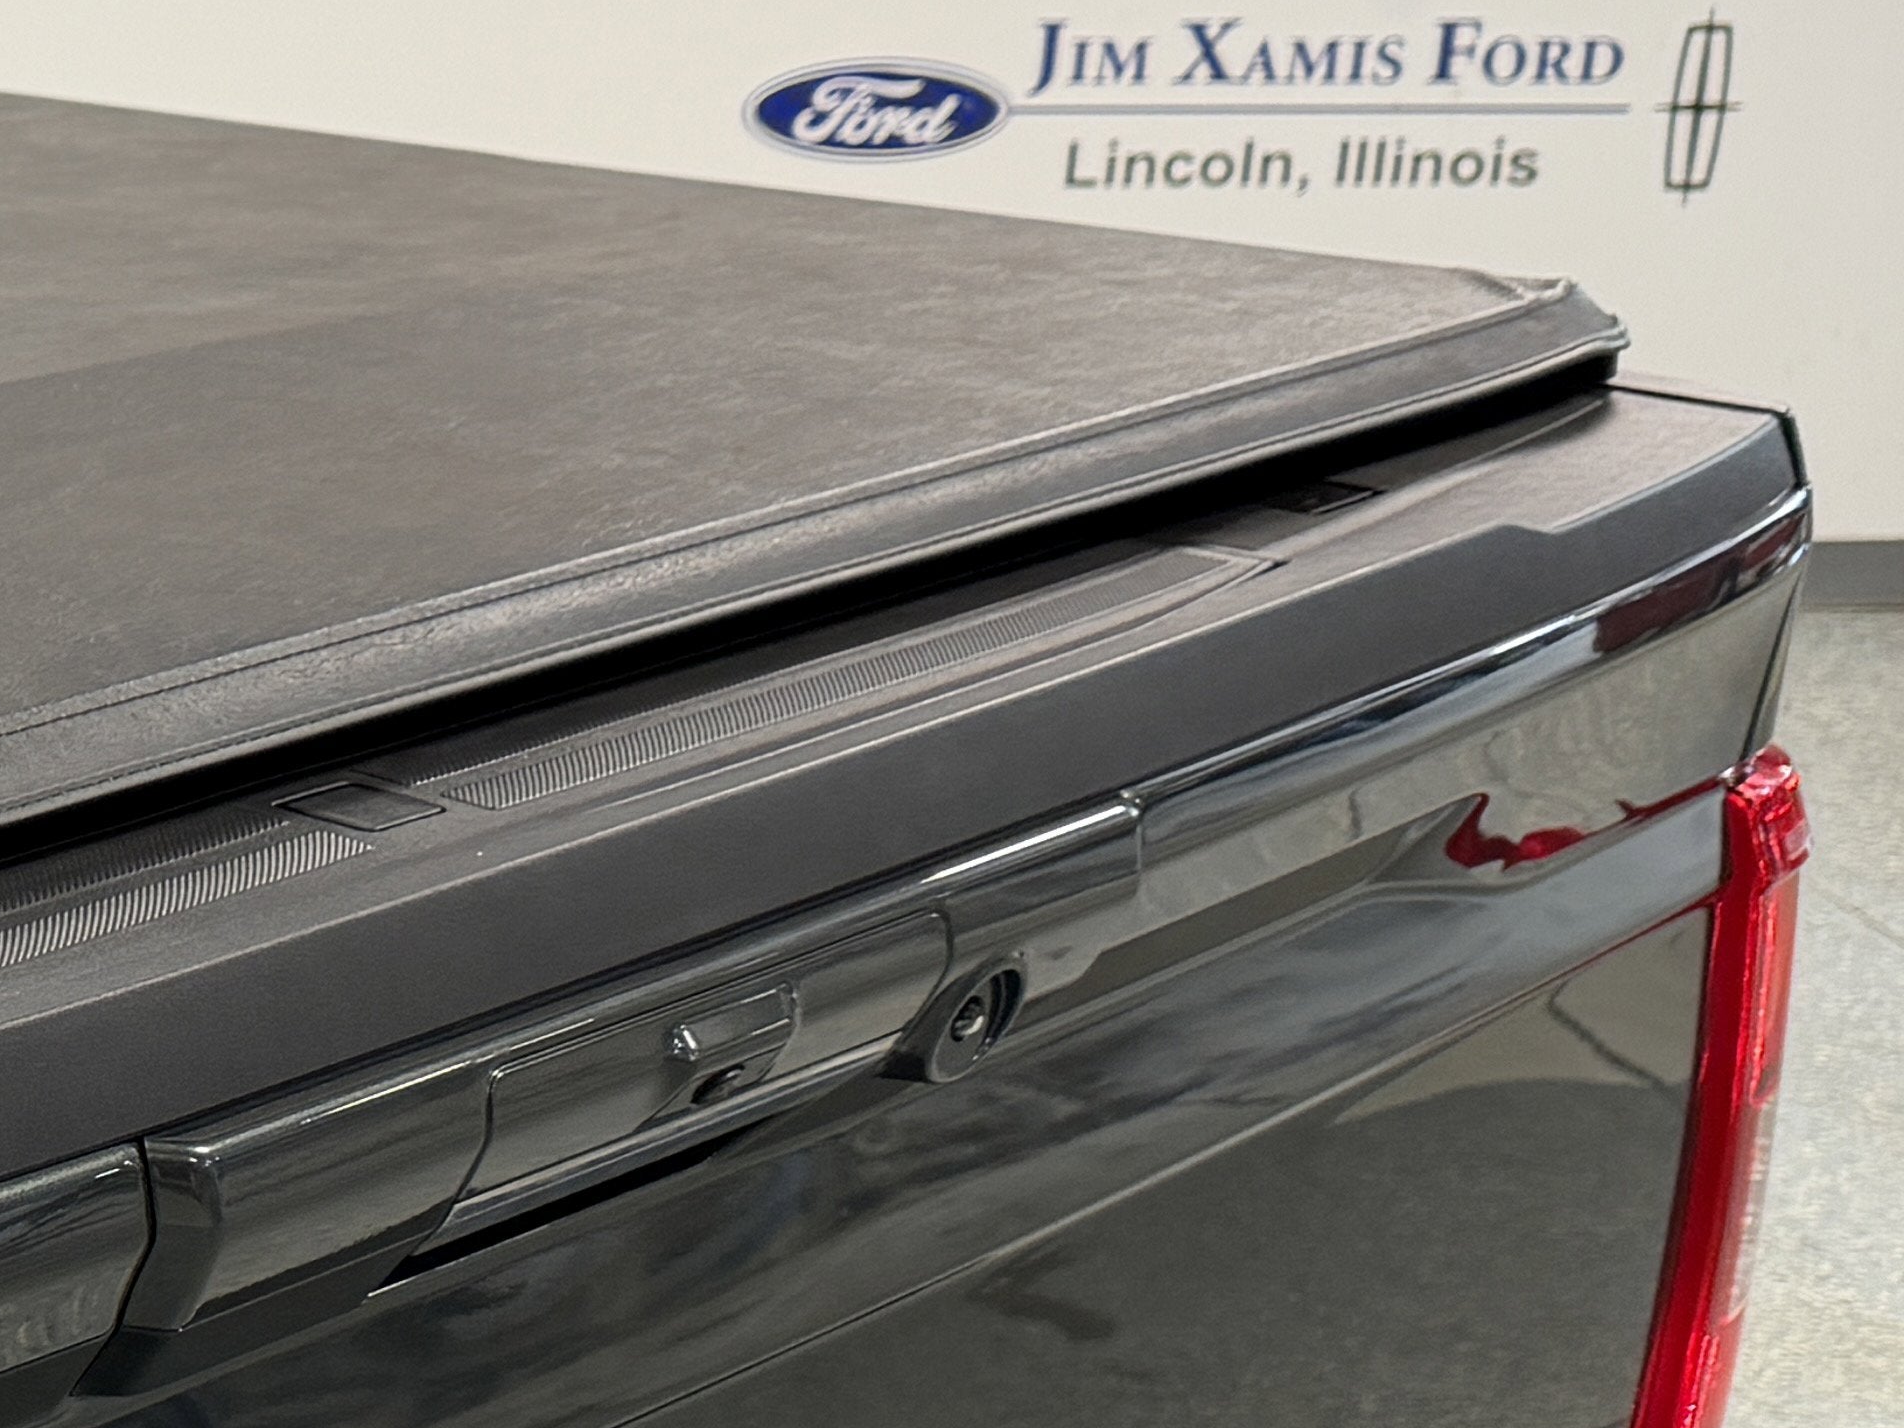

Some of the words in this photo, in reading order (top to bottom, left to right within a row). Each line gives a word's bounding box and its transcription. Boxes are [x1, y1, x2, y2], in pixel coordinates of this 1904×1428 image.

[1173, 18, 1404, 86] XAMIS
[1428, 18, 1624, 87] FORD
[792, 76, 959, 146] Ford
[1066, 137, 1310, 197] Lincoln,
[1336, 137, 1539, 190] Illinois
